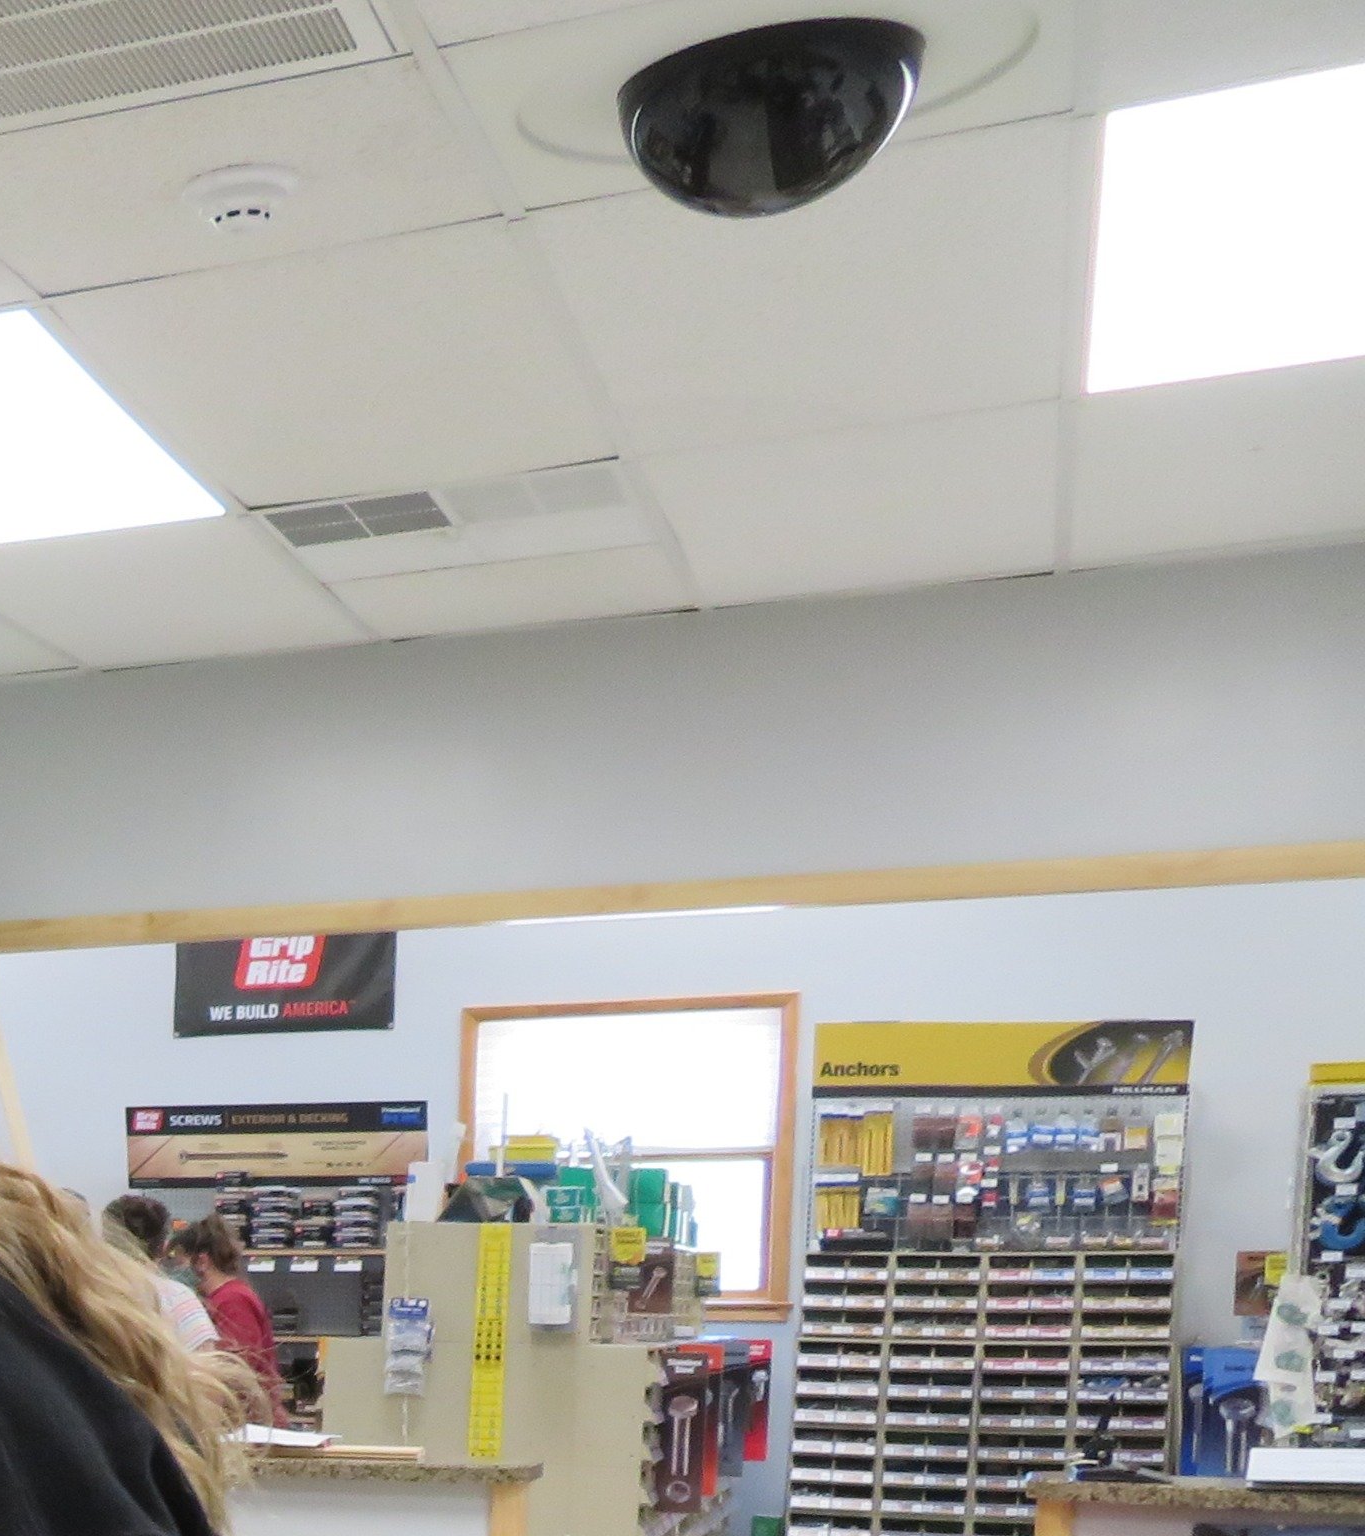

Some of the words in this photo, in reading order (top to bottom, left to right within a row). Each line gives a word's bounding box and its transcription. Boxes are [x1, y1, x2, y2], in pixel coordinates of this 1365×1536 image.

[248, 935, 316, 960] Grip
[244, 960, 308, 986] Rite
[210, 1005, 233, 1022] WE
[236, 1003, 279, 1021] BUILD
[282, 999, 349, 1018] AMERICA
[820, 1062, 900, 1077] Anchors
[1111, 1085, 1178, 1095] HILLMAN
[169, 1113, 223, 1127] SCREWS
[231, 1113, 286, 1125] EXTERIOR
